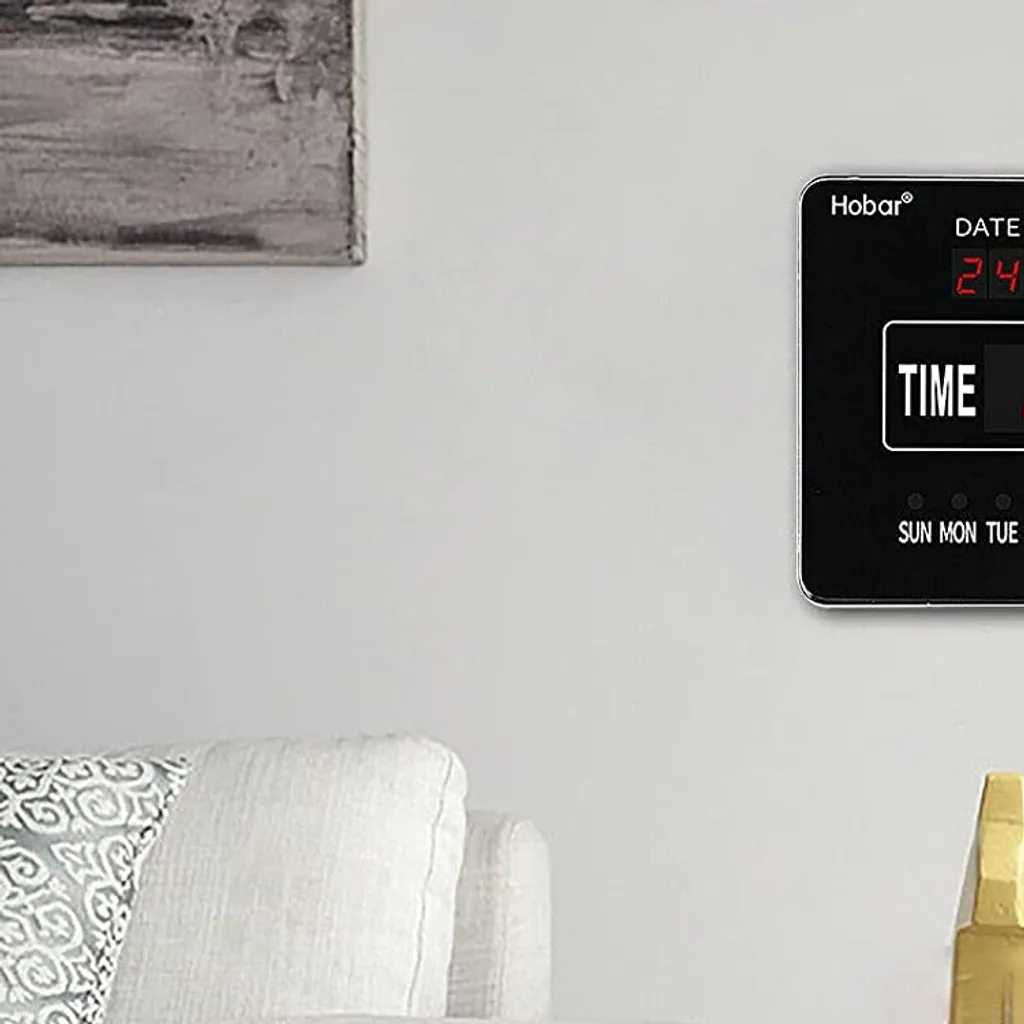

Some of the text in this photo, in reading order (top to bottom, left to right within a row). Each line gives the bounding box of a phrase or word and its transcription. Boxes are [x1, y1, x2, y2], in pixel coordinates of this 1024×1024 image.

[956, 218, 1020, 237] DATE
[957, 258, 1019, 294] 24
[898, 364, 976, 416] TIME
[899, 521, 932, 543] SUN
[940, 521, 976, 543] MON
[986, 521, 1018, 544] TUE
